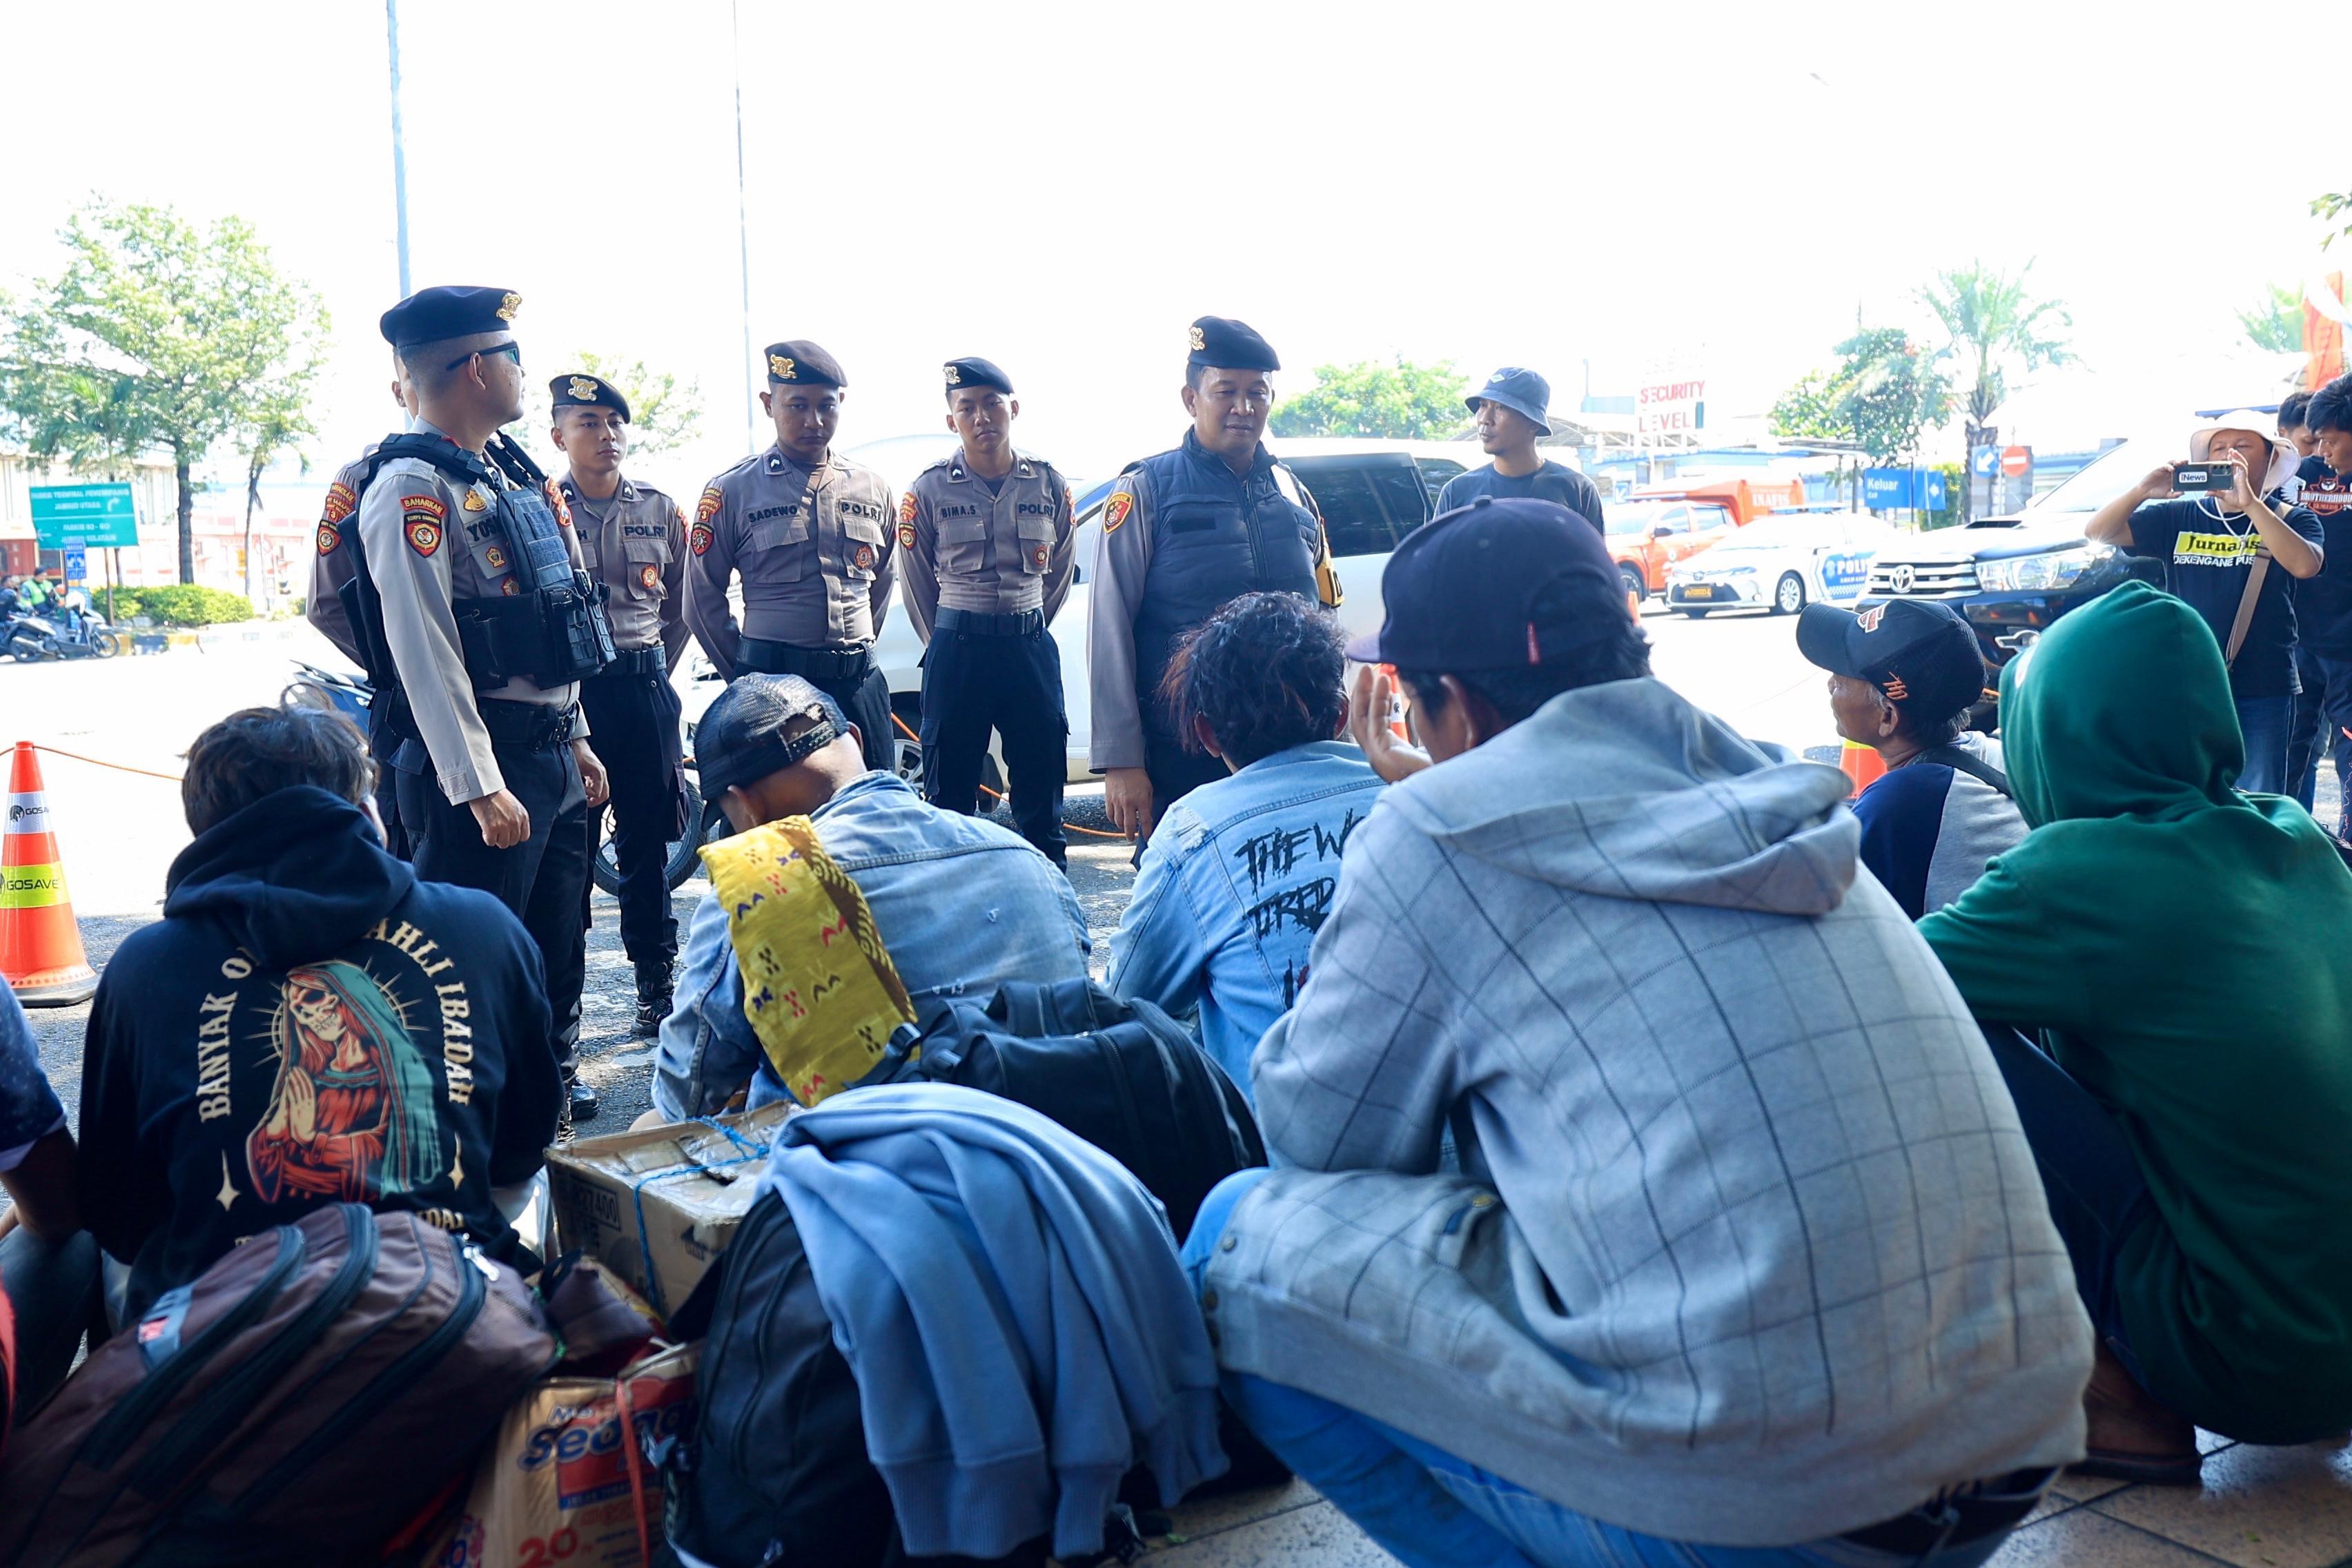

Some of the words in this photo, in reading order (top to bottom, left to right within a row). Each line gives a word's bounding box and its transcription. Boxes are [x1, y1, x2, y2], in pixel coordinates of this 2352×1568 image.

[1640, 380, 1705, 404] SECURITY
[1638, 412, 1691, 433] LEVEL
[1868, 478, 1898, 491] Keluar
[2181, 473, 2206, 482] iNews
[403, 497, 443, 514] BAHARKAN
[748, 504, 798, 523] SADEWO
[841, 501, 881, 521] POLRI
[941, 504, 976, 518] BIMA.S
[624, 525, 665, 538] POLRI
[1836, 559, 1867, 575] POLI
[6, 879, 59, 890] GOSAVE
[196, 990, 239, 1124] BANYAK
[363, 917, 455, 978] AHLI
[434, 980, 476, 1107] IBADAH
